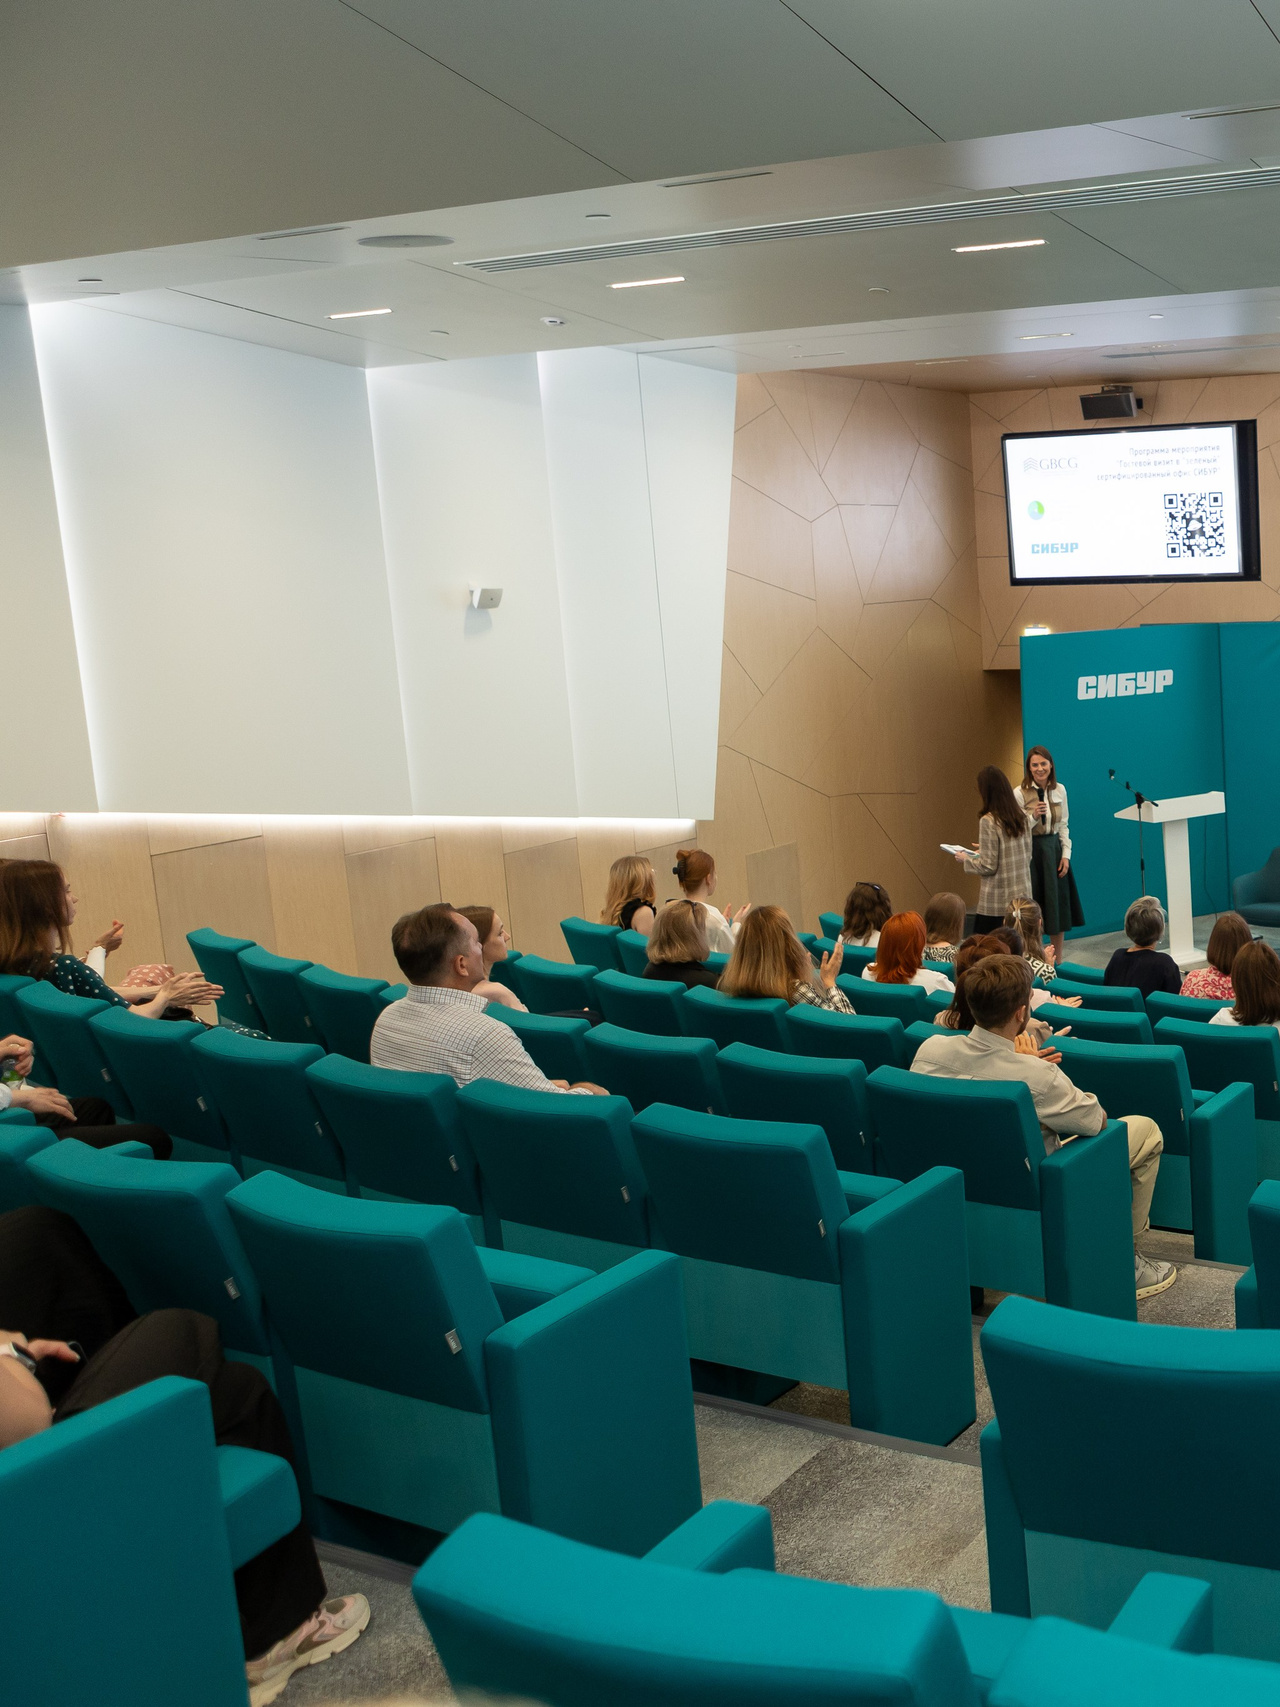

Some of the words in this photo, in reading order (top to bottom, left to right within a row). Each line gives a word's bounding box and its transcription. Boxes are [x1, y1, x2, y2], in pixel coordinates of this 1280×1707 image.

[1129, 447, 1170, 456] Программа
[1172, 445, 1220, 454] мероприятия
[1039, 457, 1078, 470] GBCG
[1154, 459, 1173, 467] визит
[1097, 469, 1171, 481] сертифицированный
[1031, 542, 1079, 555] СИБУР
[1077, 669, 1174, 701] СИБУР
